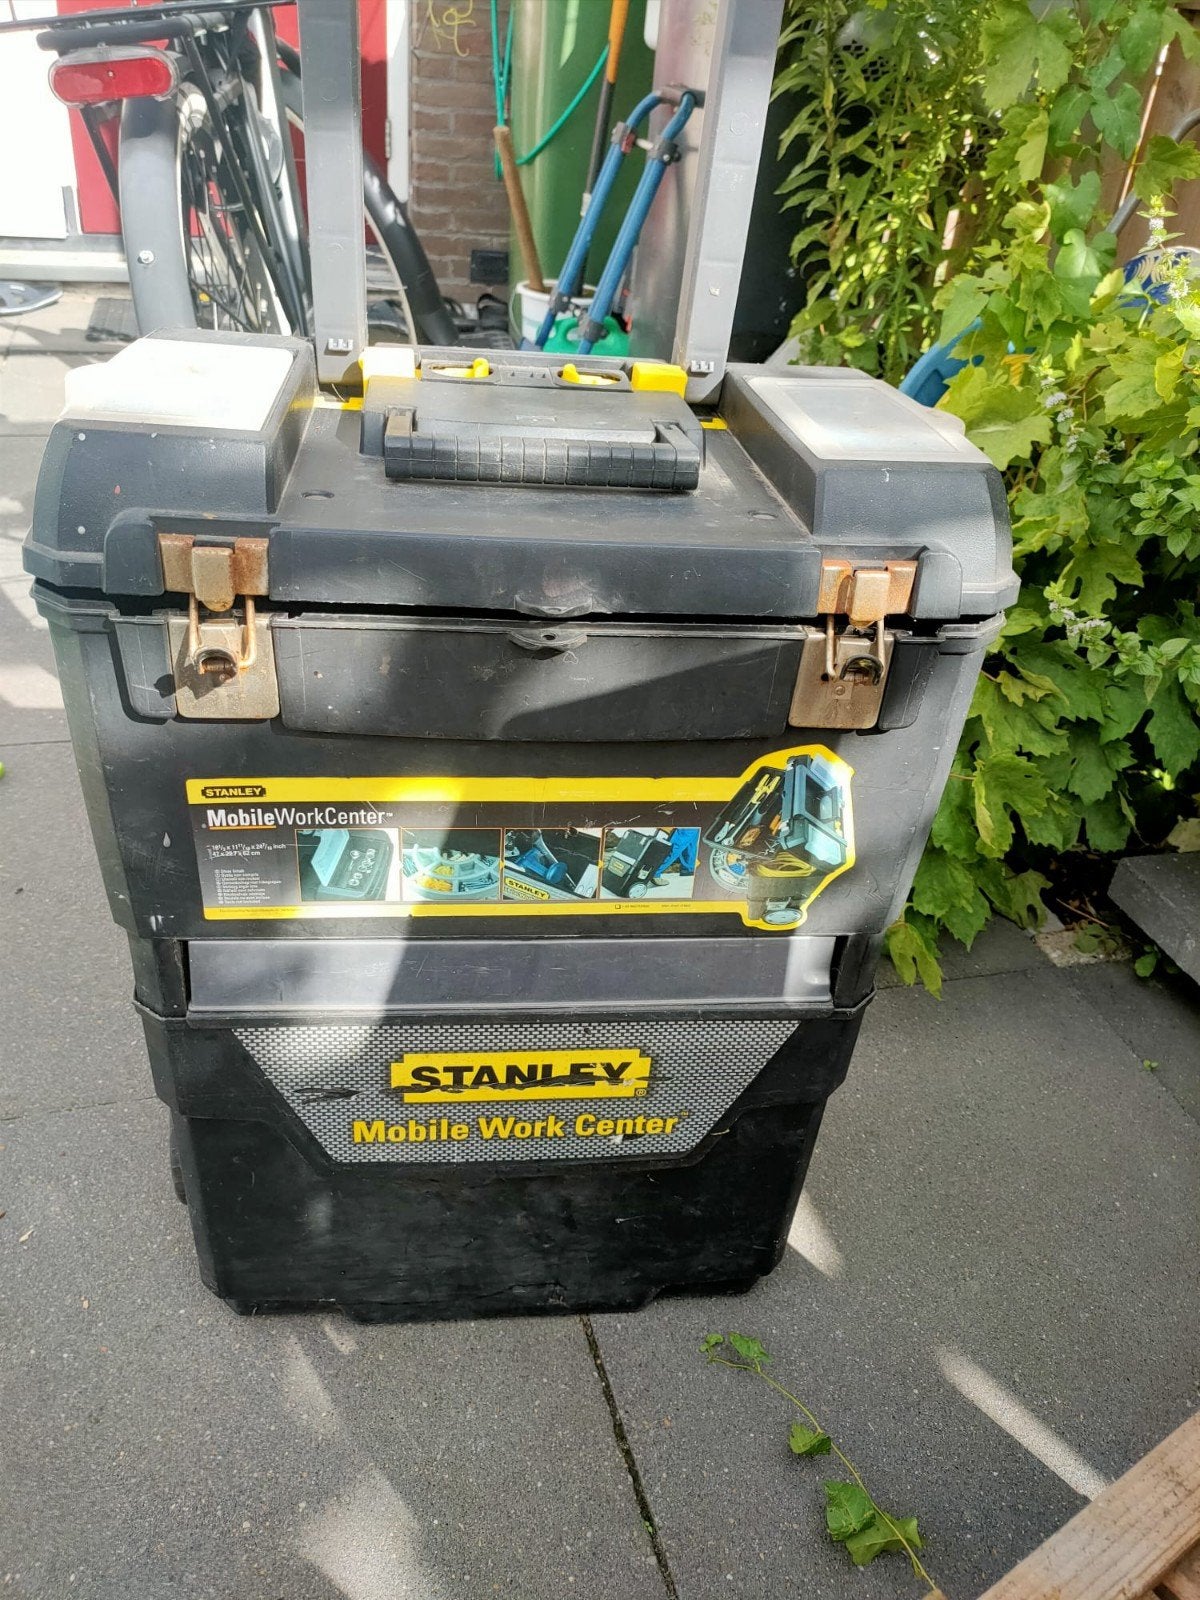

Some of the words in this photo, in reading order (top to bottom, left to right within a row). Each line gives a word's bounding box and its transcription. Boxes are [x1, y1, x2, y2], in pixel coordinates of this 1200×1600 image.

[205, 787, 262, 797] STANLEY
[508, 880, 546, 898] STANLEY
[410, 1061, 633, 1088] STANLEY
[353, 1117, 469, 1143] Mobile
[478, 1115, 566, 1140] Work
